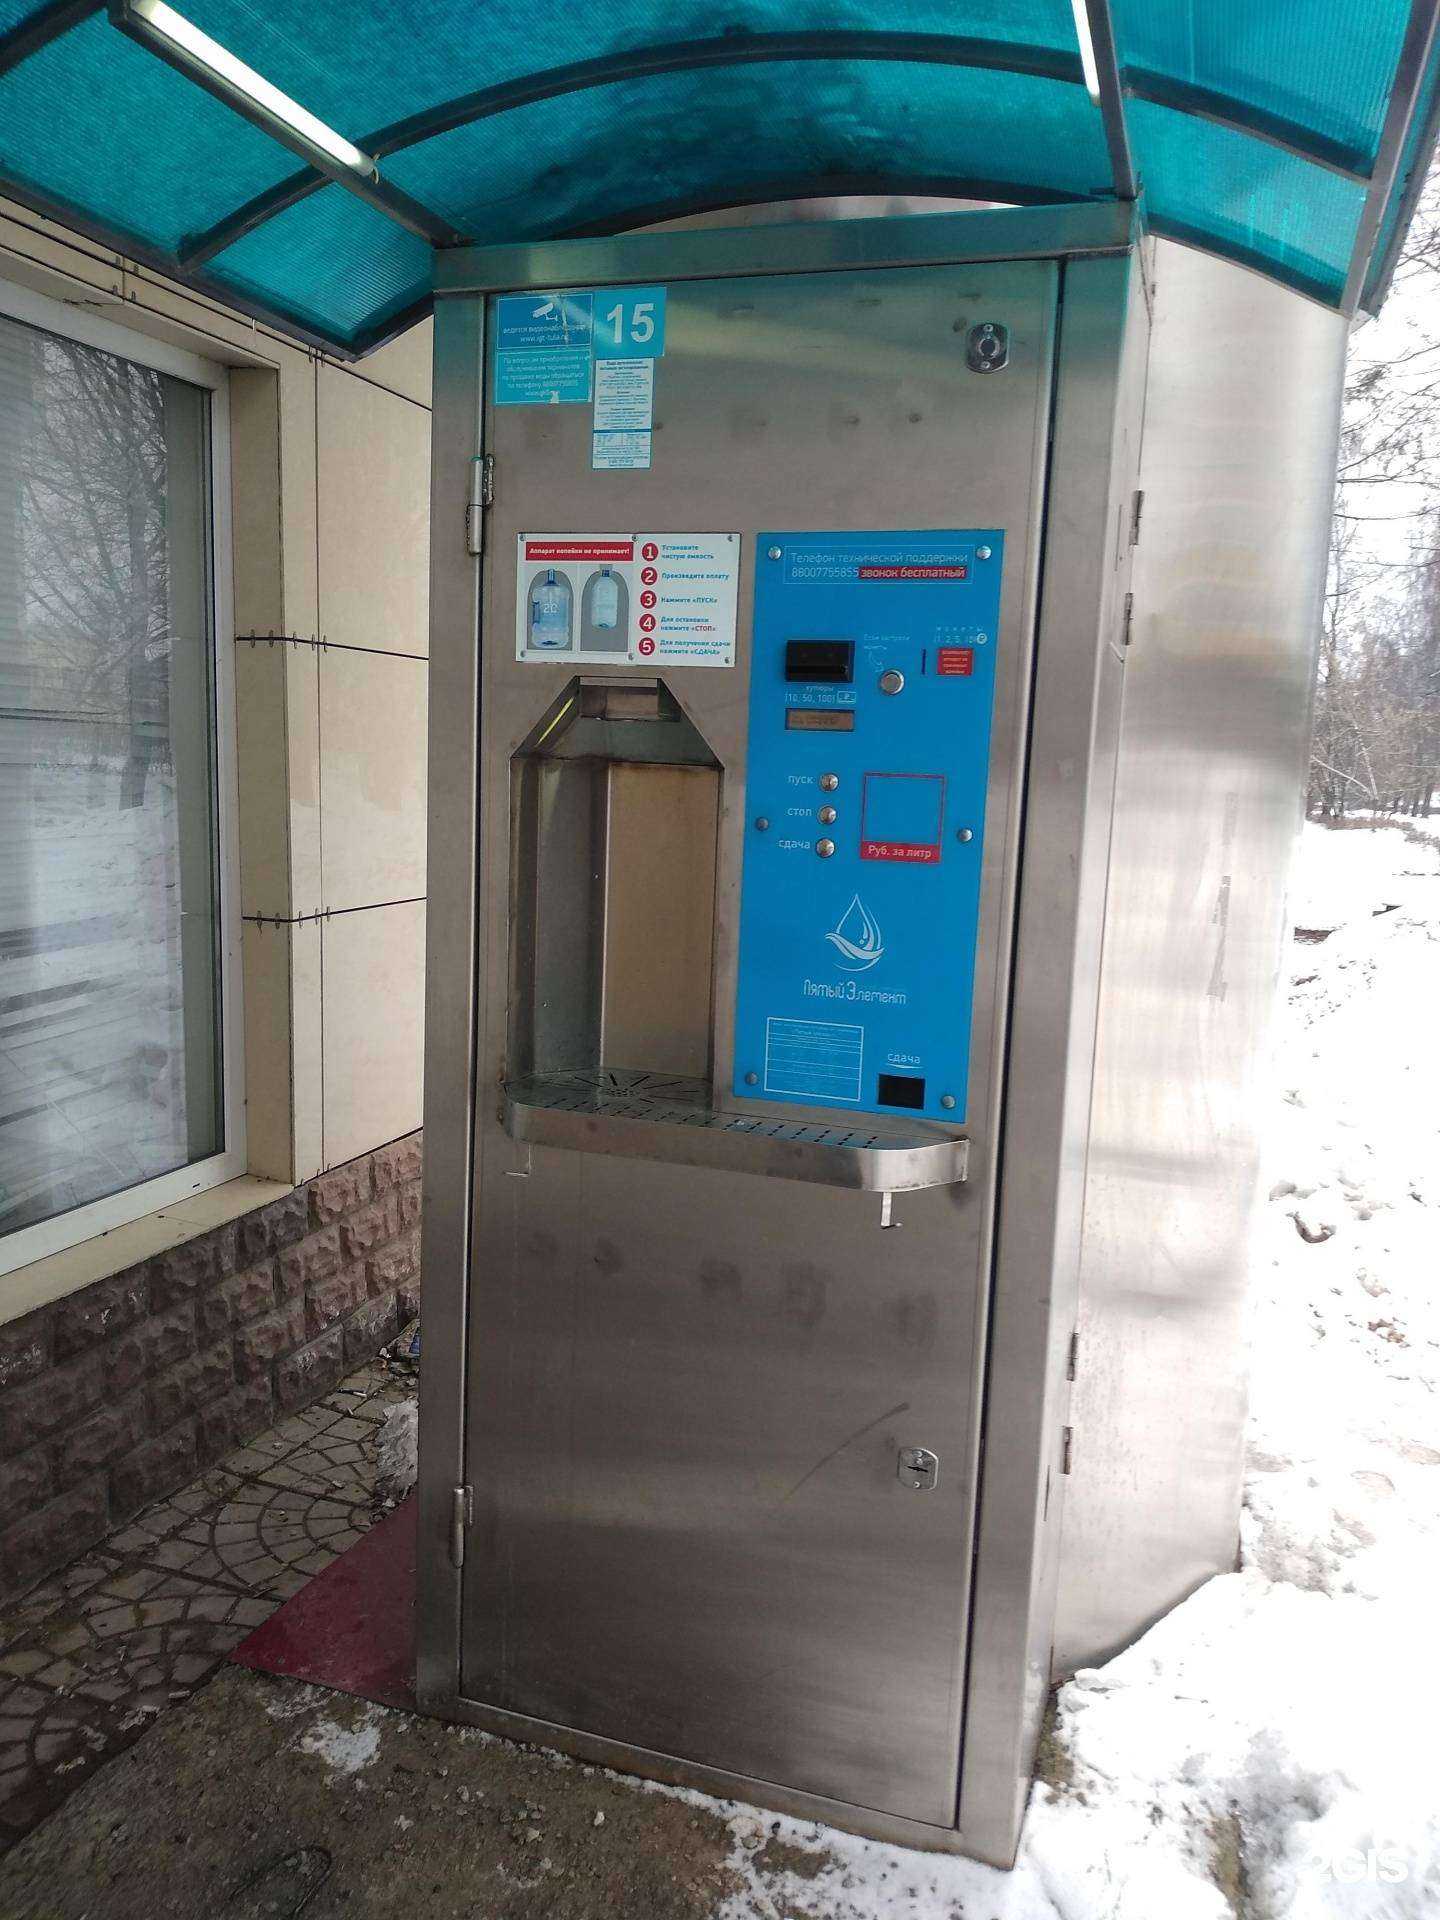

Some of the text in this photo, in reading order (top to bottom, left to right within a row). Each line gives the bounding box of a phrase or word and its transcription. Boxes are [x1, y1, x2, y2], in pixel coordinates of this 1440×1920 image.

[606, 303, 655, 343] 15
[646, 545, 654, 559] 1
[791, 551, 968, 565] Телефон технической поддержки
[644, 569, 654, 583] 2
[661, 572, 705, 580] Произведите
[861, 568, 898, 578] звонок
[899, 566, 966, 579] бесплатный
[644, 593, 653, 606] 3
[643, 616, 654, 630] 4
[642, 640, 652, 654] 5
[788, 774, 814, 786] пуск
[786, 807, 812, 817] стоп
[778, 839, 811, 851] сдача
[867, 844, 932, 860] Руб. за литр
[887, 1052, 921, 1064] сдача
